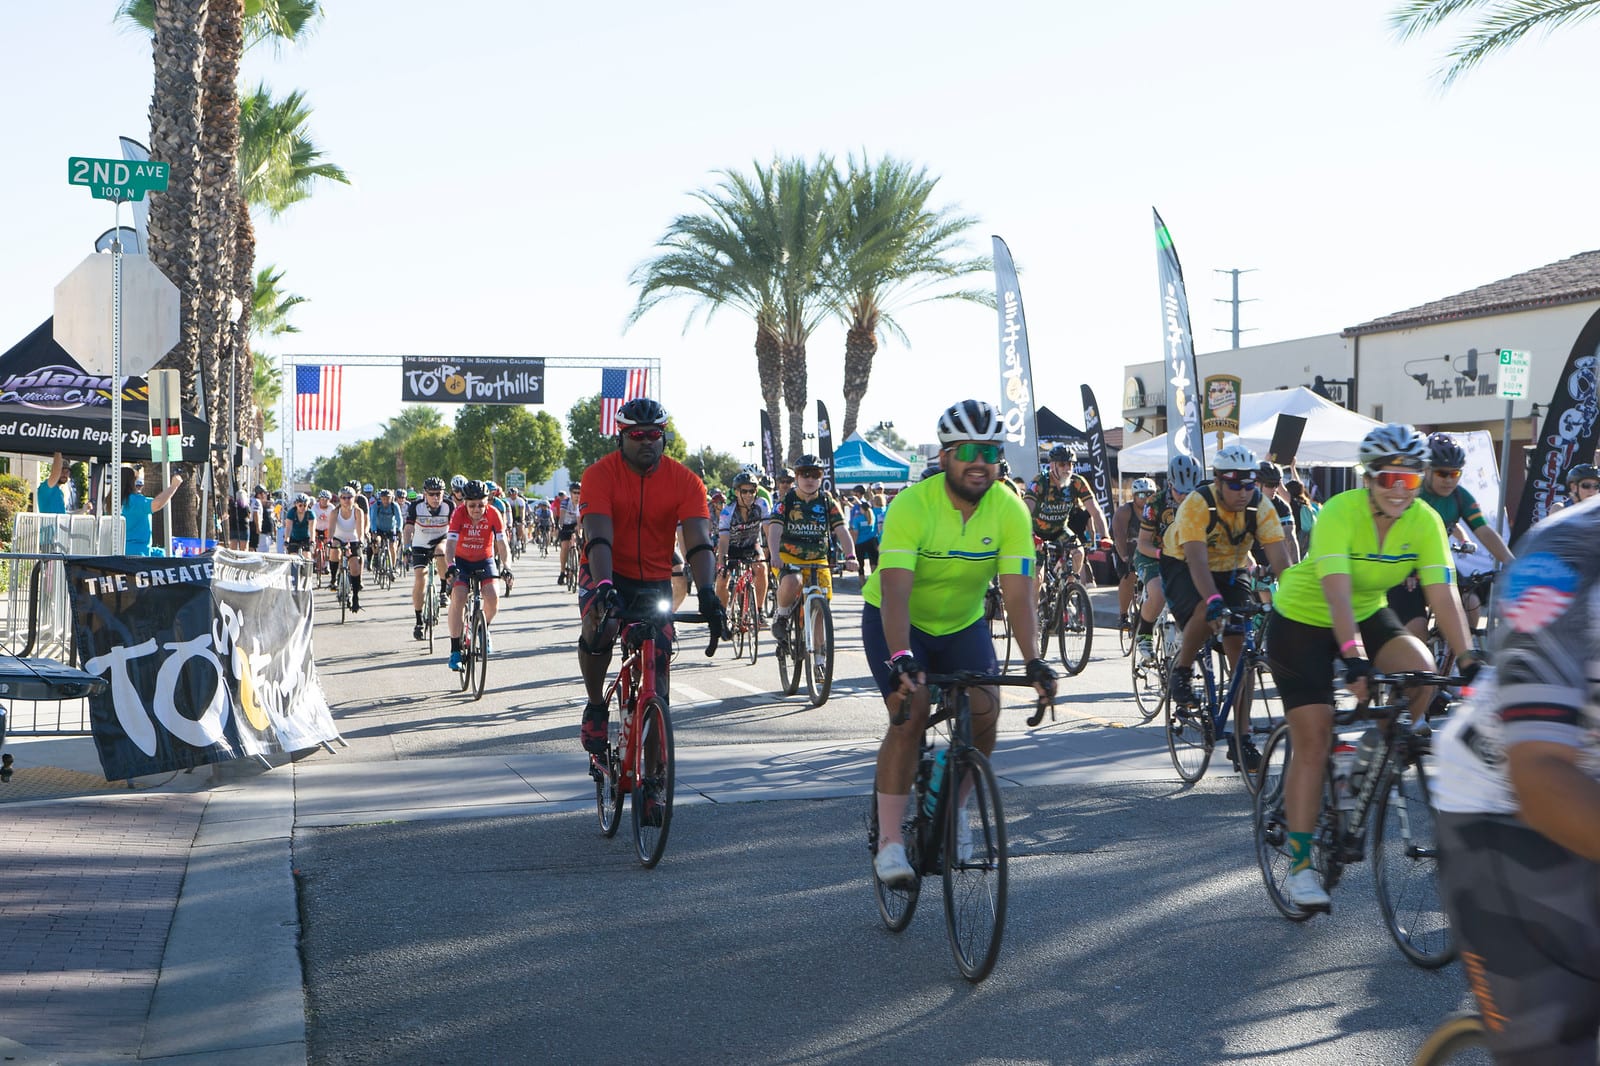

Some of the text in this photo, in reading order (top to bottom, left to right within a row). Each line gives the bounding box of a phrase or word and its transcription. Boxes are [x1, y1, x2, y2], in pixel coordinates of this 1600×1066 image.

[73, 160, 164, 185] 2ND AVE
[101, 187, 135, 198] 100 N
[1502, 351, 1510, 363] 3
[464, 370, 539, 400] Foothills
[20, 422, 79, 440] Collision
[82, 427, 128, 446] Repr
[129, 430, 195, 448] Spest
[787, 522, 826, 531] DAMIEN
[85, 574, 128, 596] THE
